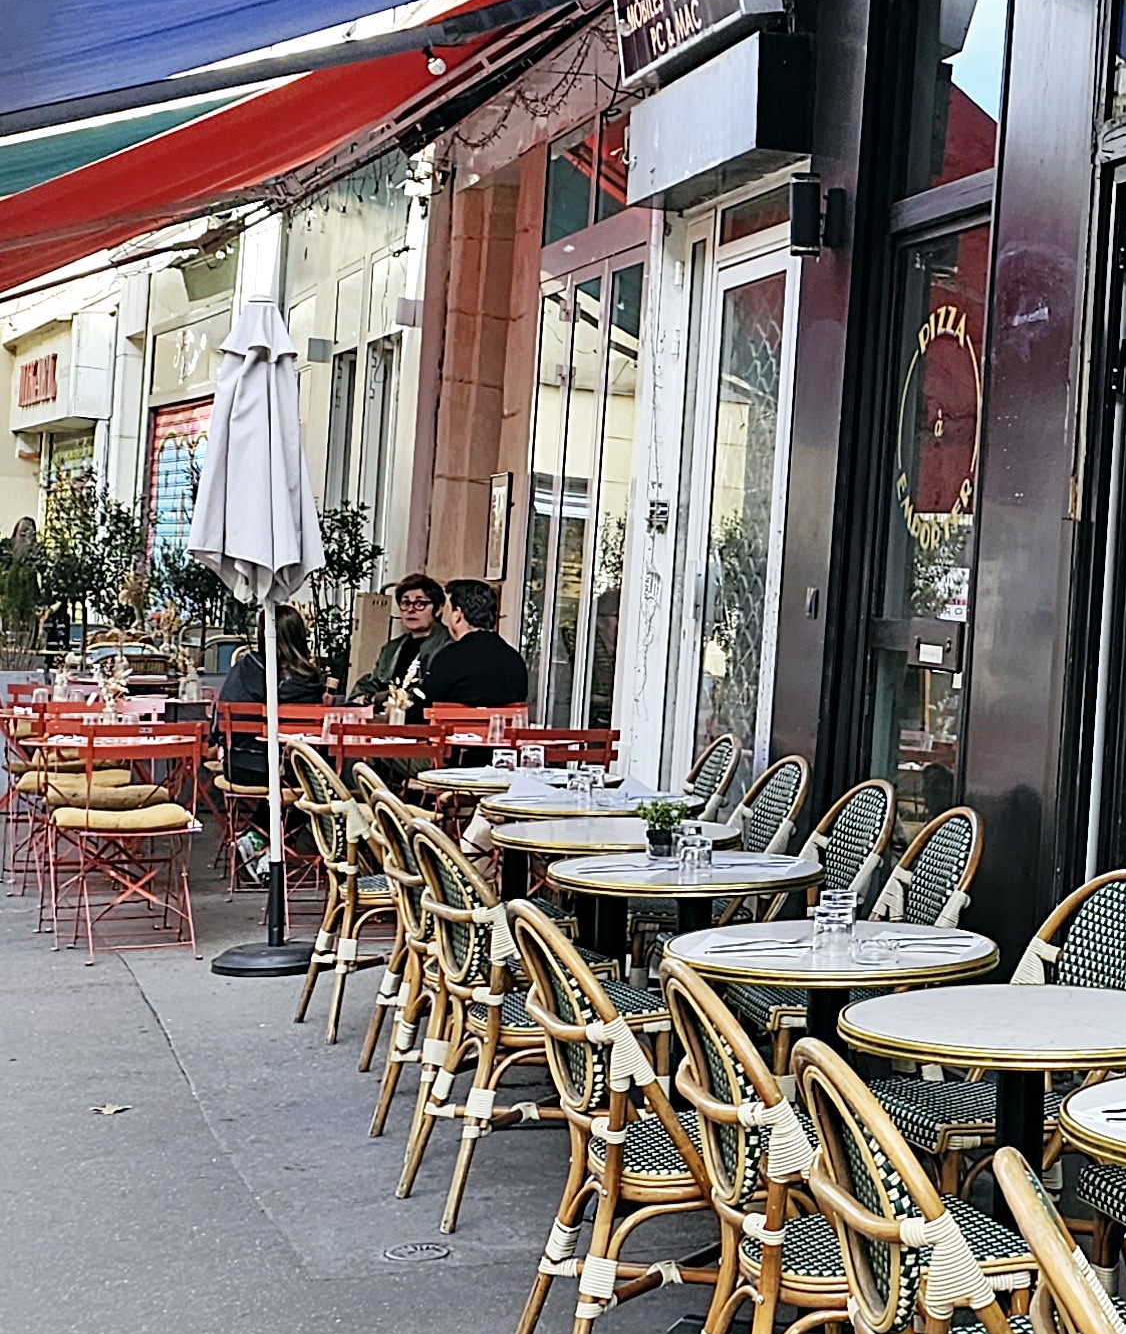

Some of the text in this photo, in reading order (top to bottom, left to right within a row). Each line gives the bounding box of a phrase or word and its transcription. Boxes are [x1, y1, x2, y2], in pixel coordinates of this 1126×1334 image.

[649, 21, 666, 56] PC
[918, 305, 967, 355] PIZZA
[896, 471, 973, 551] EMPORTER
